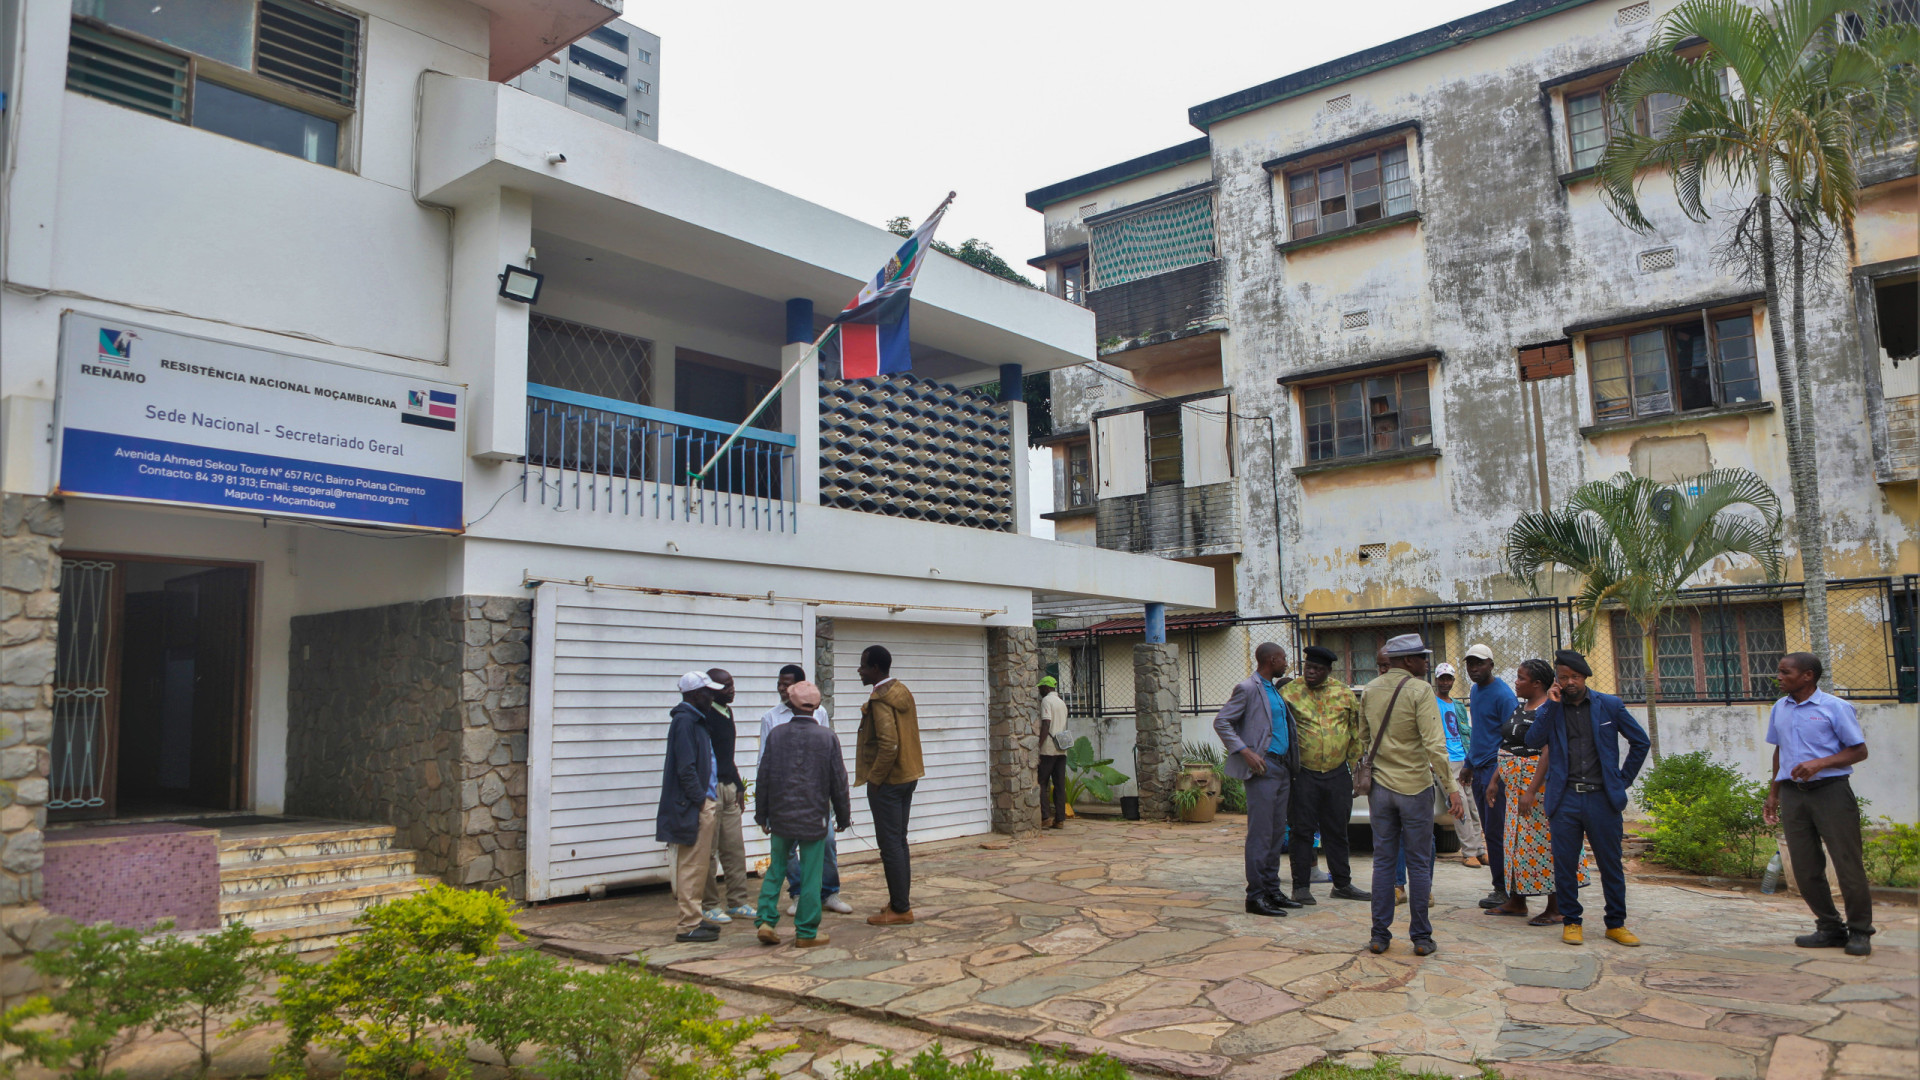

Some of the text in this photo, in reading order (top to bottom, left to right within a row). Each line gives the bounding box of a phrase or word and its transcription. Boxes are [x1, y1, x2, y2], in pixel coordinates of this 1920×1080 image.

[81, 364, 146, 384] RENAMO
[160, 359, 397, 409] RESISTÊNCIA NACIONAL MOÇAMBICANA
[145, 404, 187, 424] Sede
[192, 411, 260, 435] Nacional
[275, 424, 364, 450] Secretariado
[369, 439, 404, 456] Geral
[114, 447, 161, 462] Avenida
[163, 453, 203, 467] Ahmed
[204, 459, 238, 472] Sekou
[240, 463, 269, 476] Touré
[285, 470, 301, 480] 657
[326, 475, 354, 486] Bairro
[356, 479, 387, 491] Polana
[388, 483, 425, 496] Cimento
[138, 464, 193, 480] Contacto:
[195, 472, 209, 482] 84
[211, 474, 224, 484] 39
[226, 476, 237, 485] 81
[260, 480, 291, 491] Email:
[292, 484, 409, 506] secgeral@renamo.org.mz
[225, 488, 264, 502] Maputo
[273, 494, 336, 510] Moçambique
